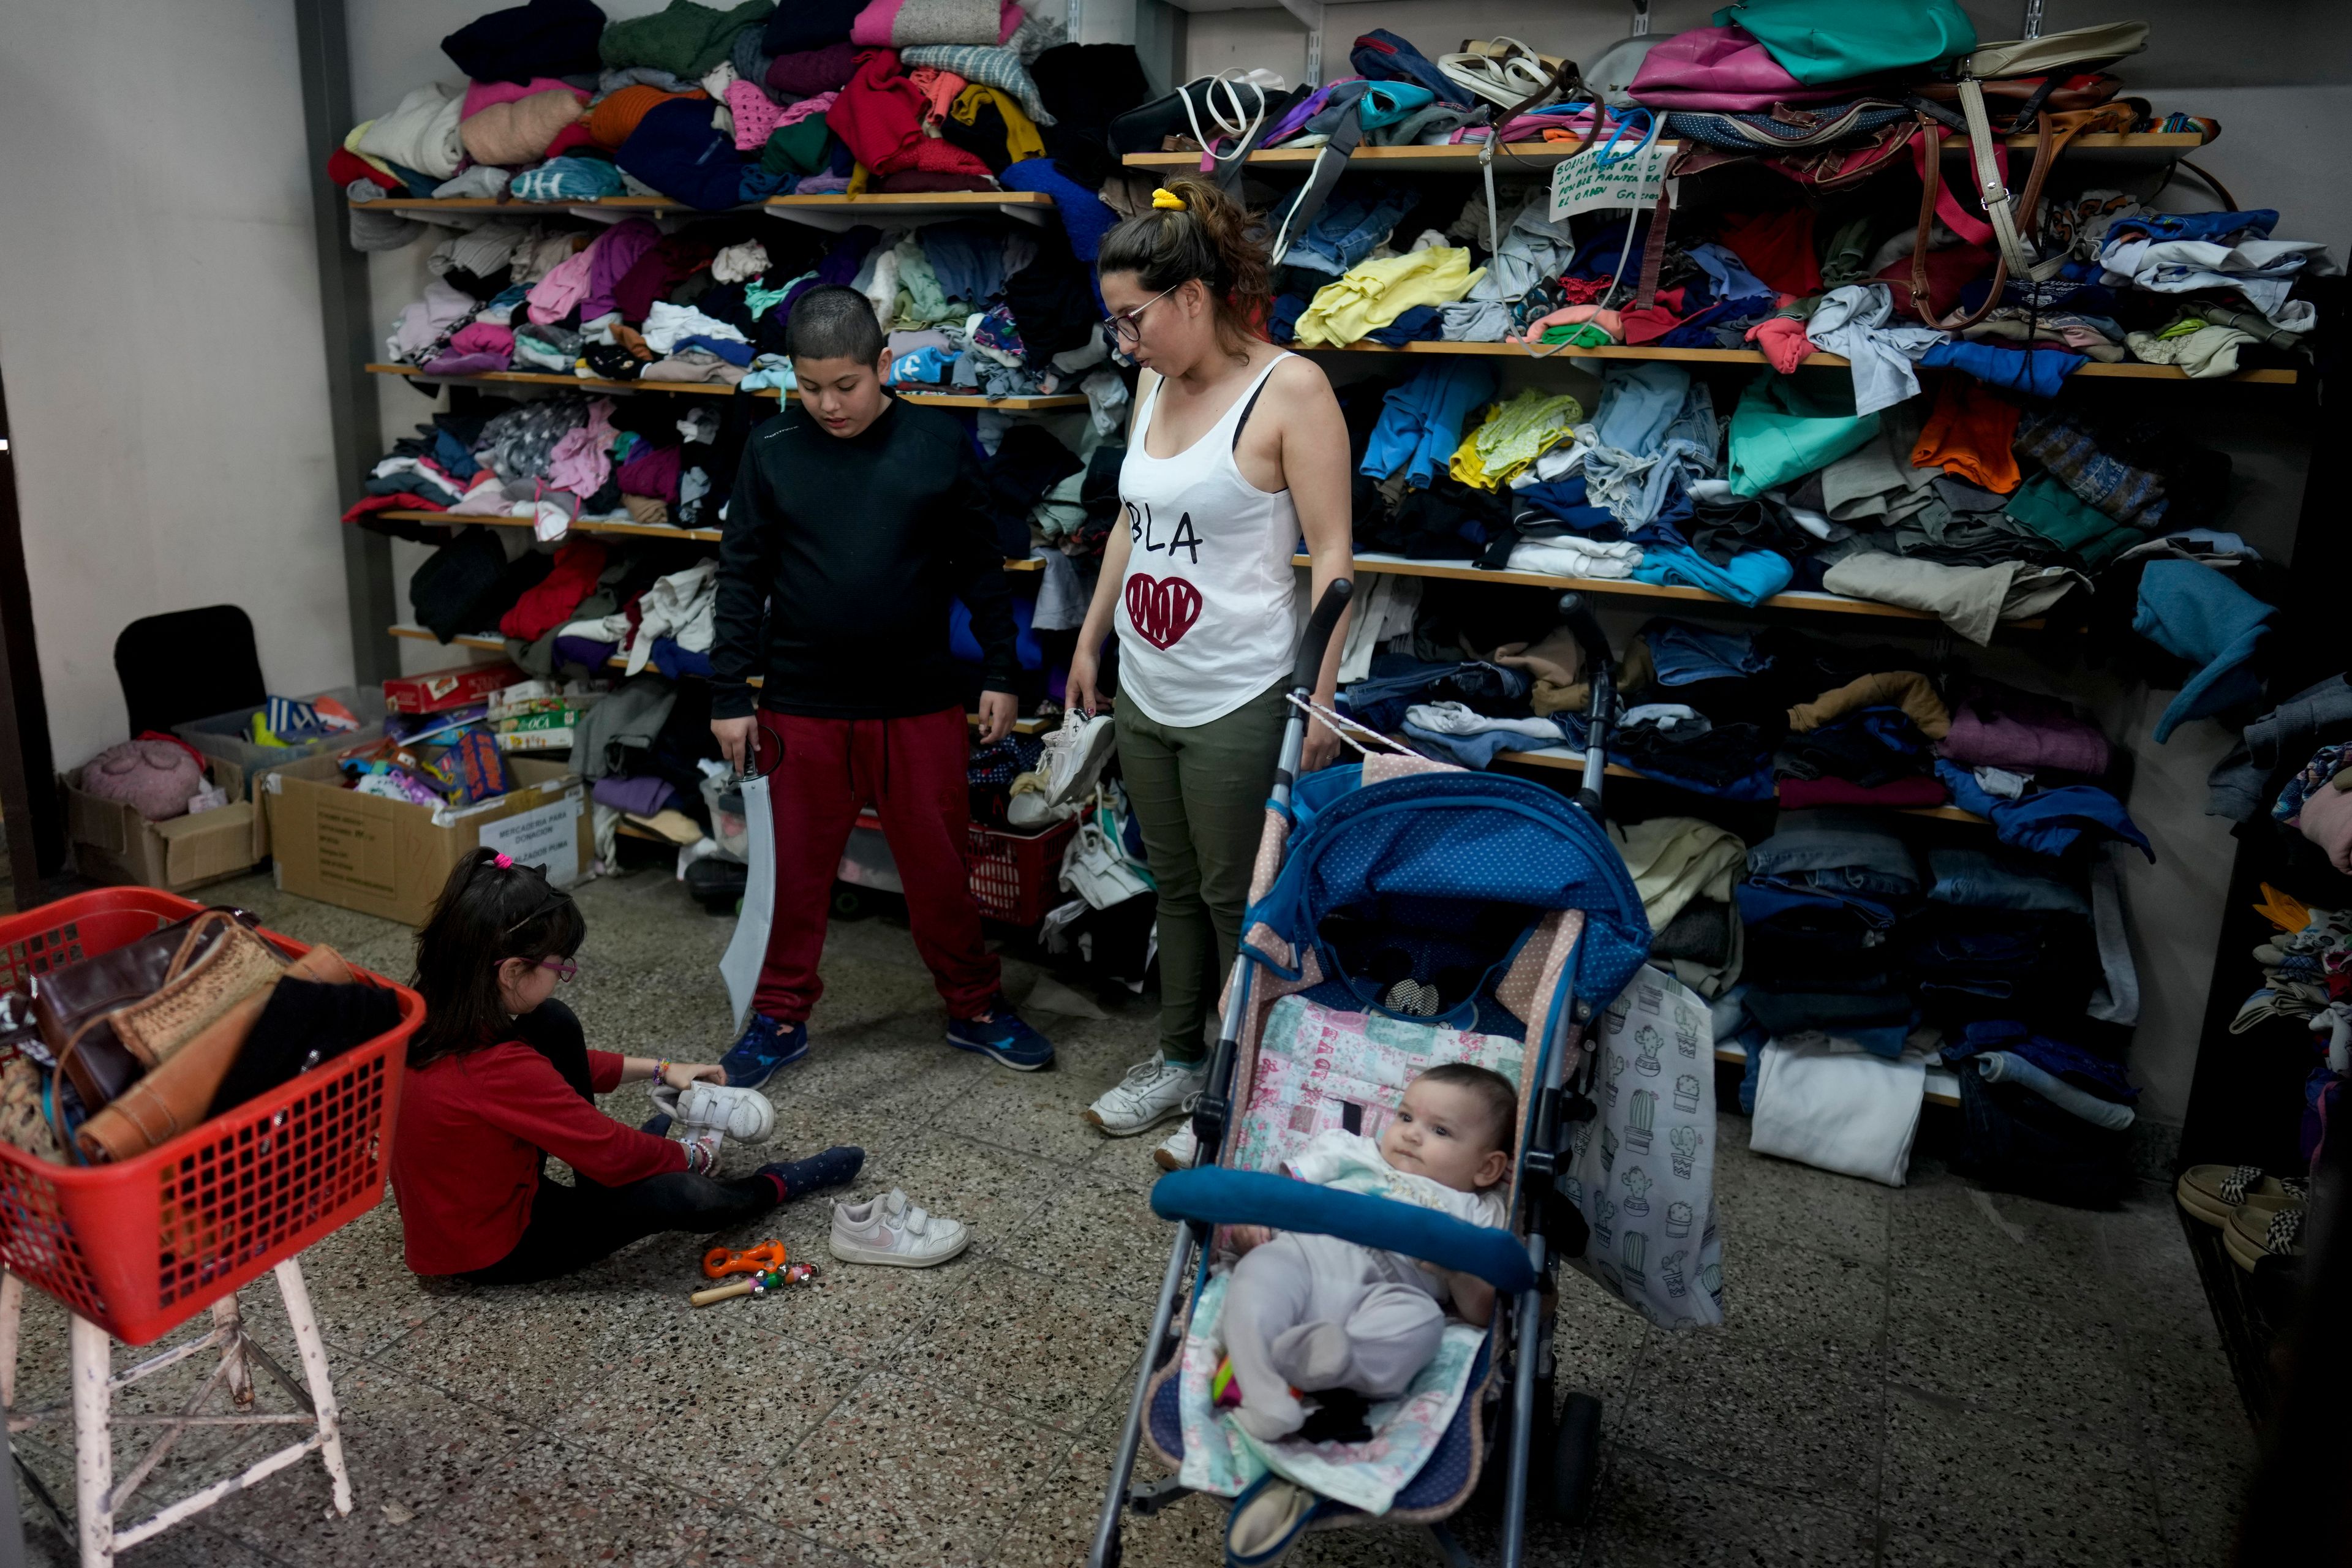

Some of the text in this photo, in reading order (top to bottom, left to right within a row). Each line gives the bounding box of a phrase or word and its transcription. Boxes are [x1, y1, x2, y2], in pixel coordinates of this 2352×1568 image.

[1558, 174, 1571, 186] LA
[1621, 162, 1637, 172] DE
[1559, 175, 1592, 197] POSIBLE
[1558, 197, 1569, 208] EL
[1575, 186, 1607, 201] ORDEN
[1123, 495, 1203, 564] BLA
[528, 714, 550, 730] OCA
[499, 812, 567, 839] MERCADERIA PARA
[515, 827, 553, 844] DONACION
[514, 840, 568, 864] ALZADOS PUMA
[1310, 1027, 1338, 1080] LOVE
